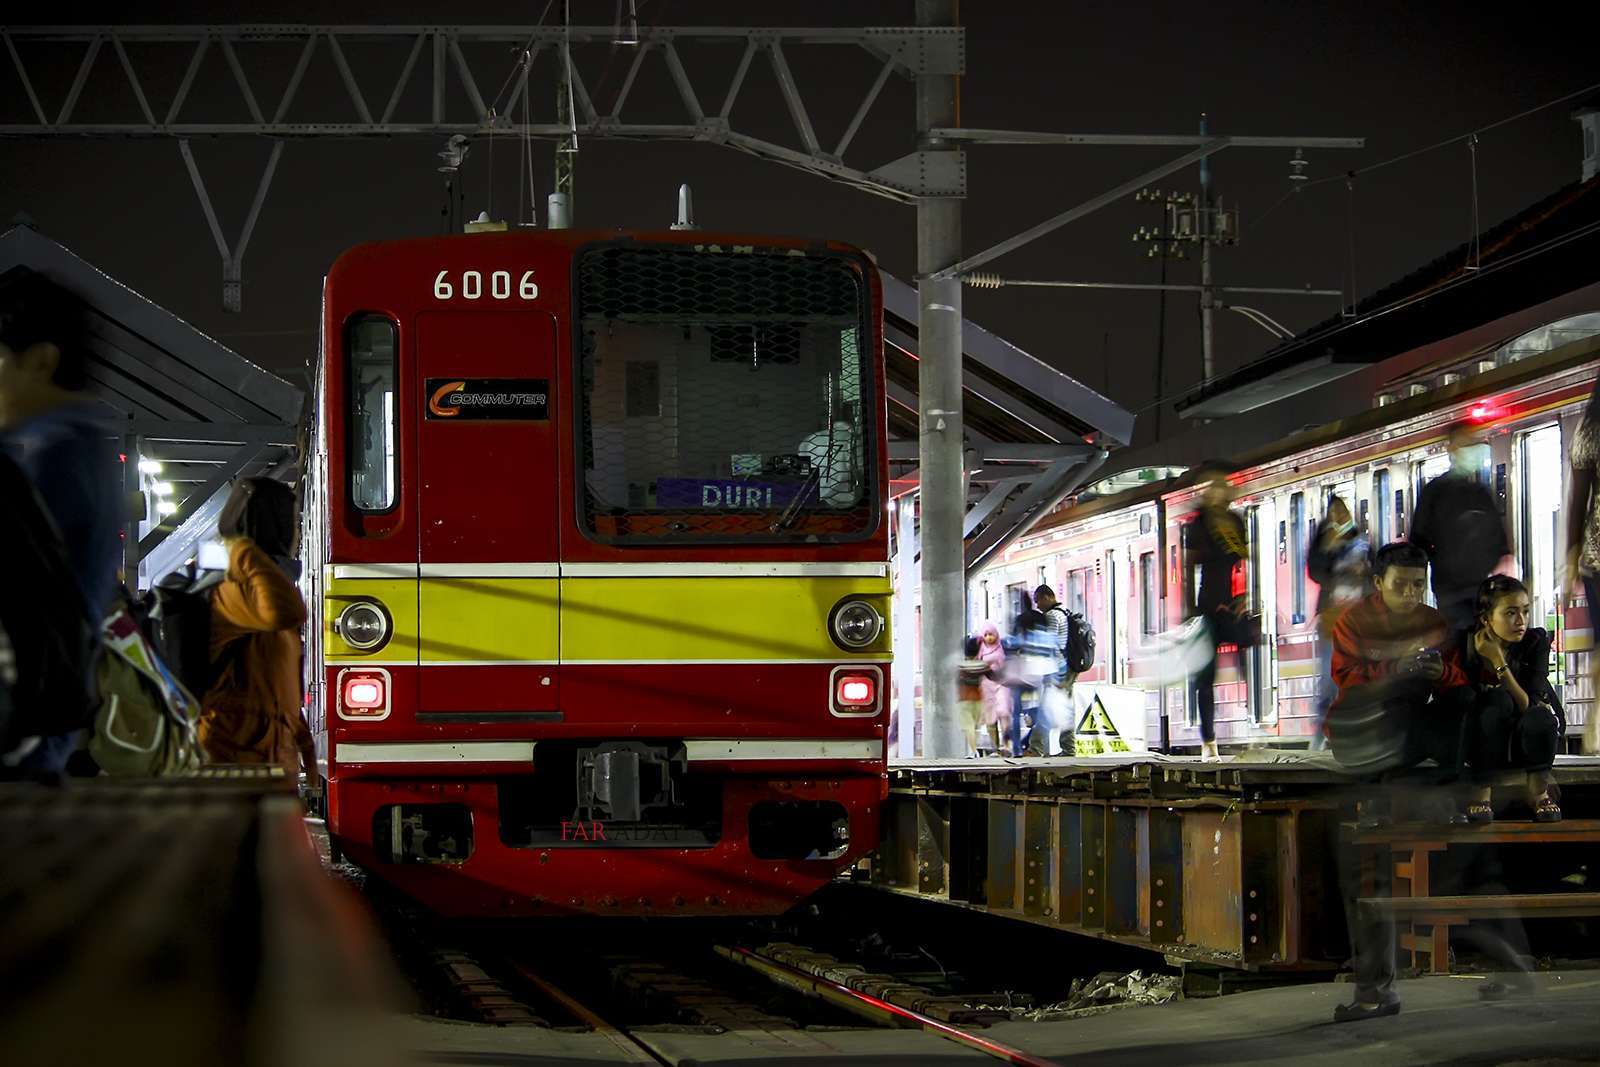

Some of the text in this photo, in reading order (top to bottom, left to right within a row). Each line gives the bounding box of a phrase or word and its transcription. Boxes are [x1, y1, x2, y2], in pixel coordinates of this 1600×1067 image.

[434, 270, 538, 300] 6006
[449, 393, 546, 405] COMMUTER
[702, 484, 772, 508] DURI
